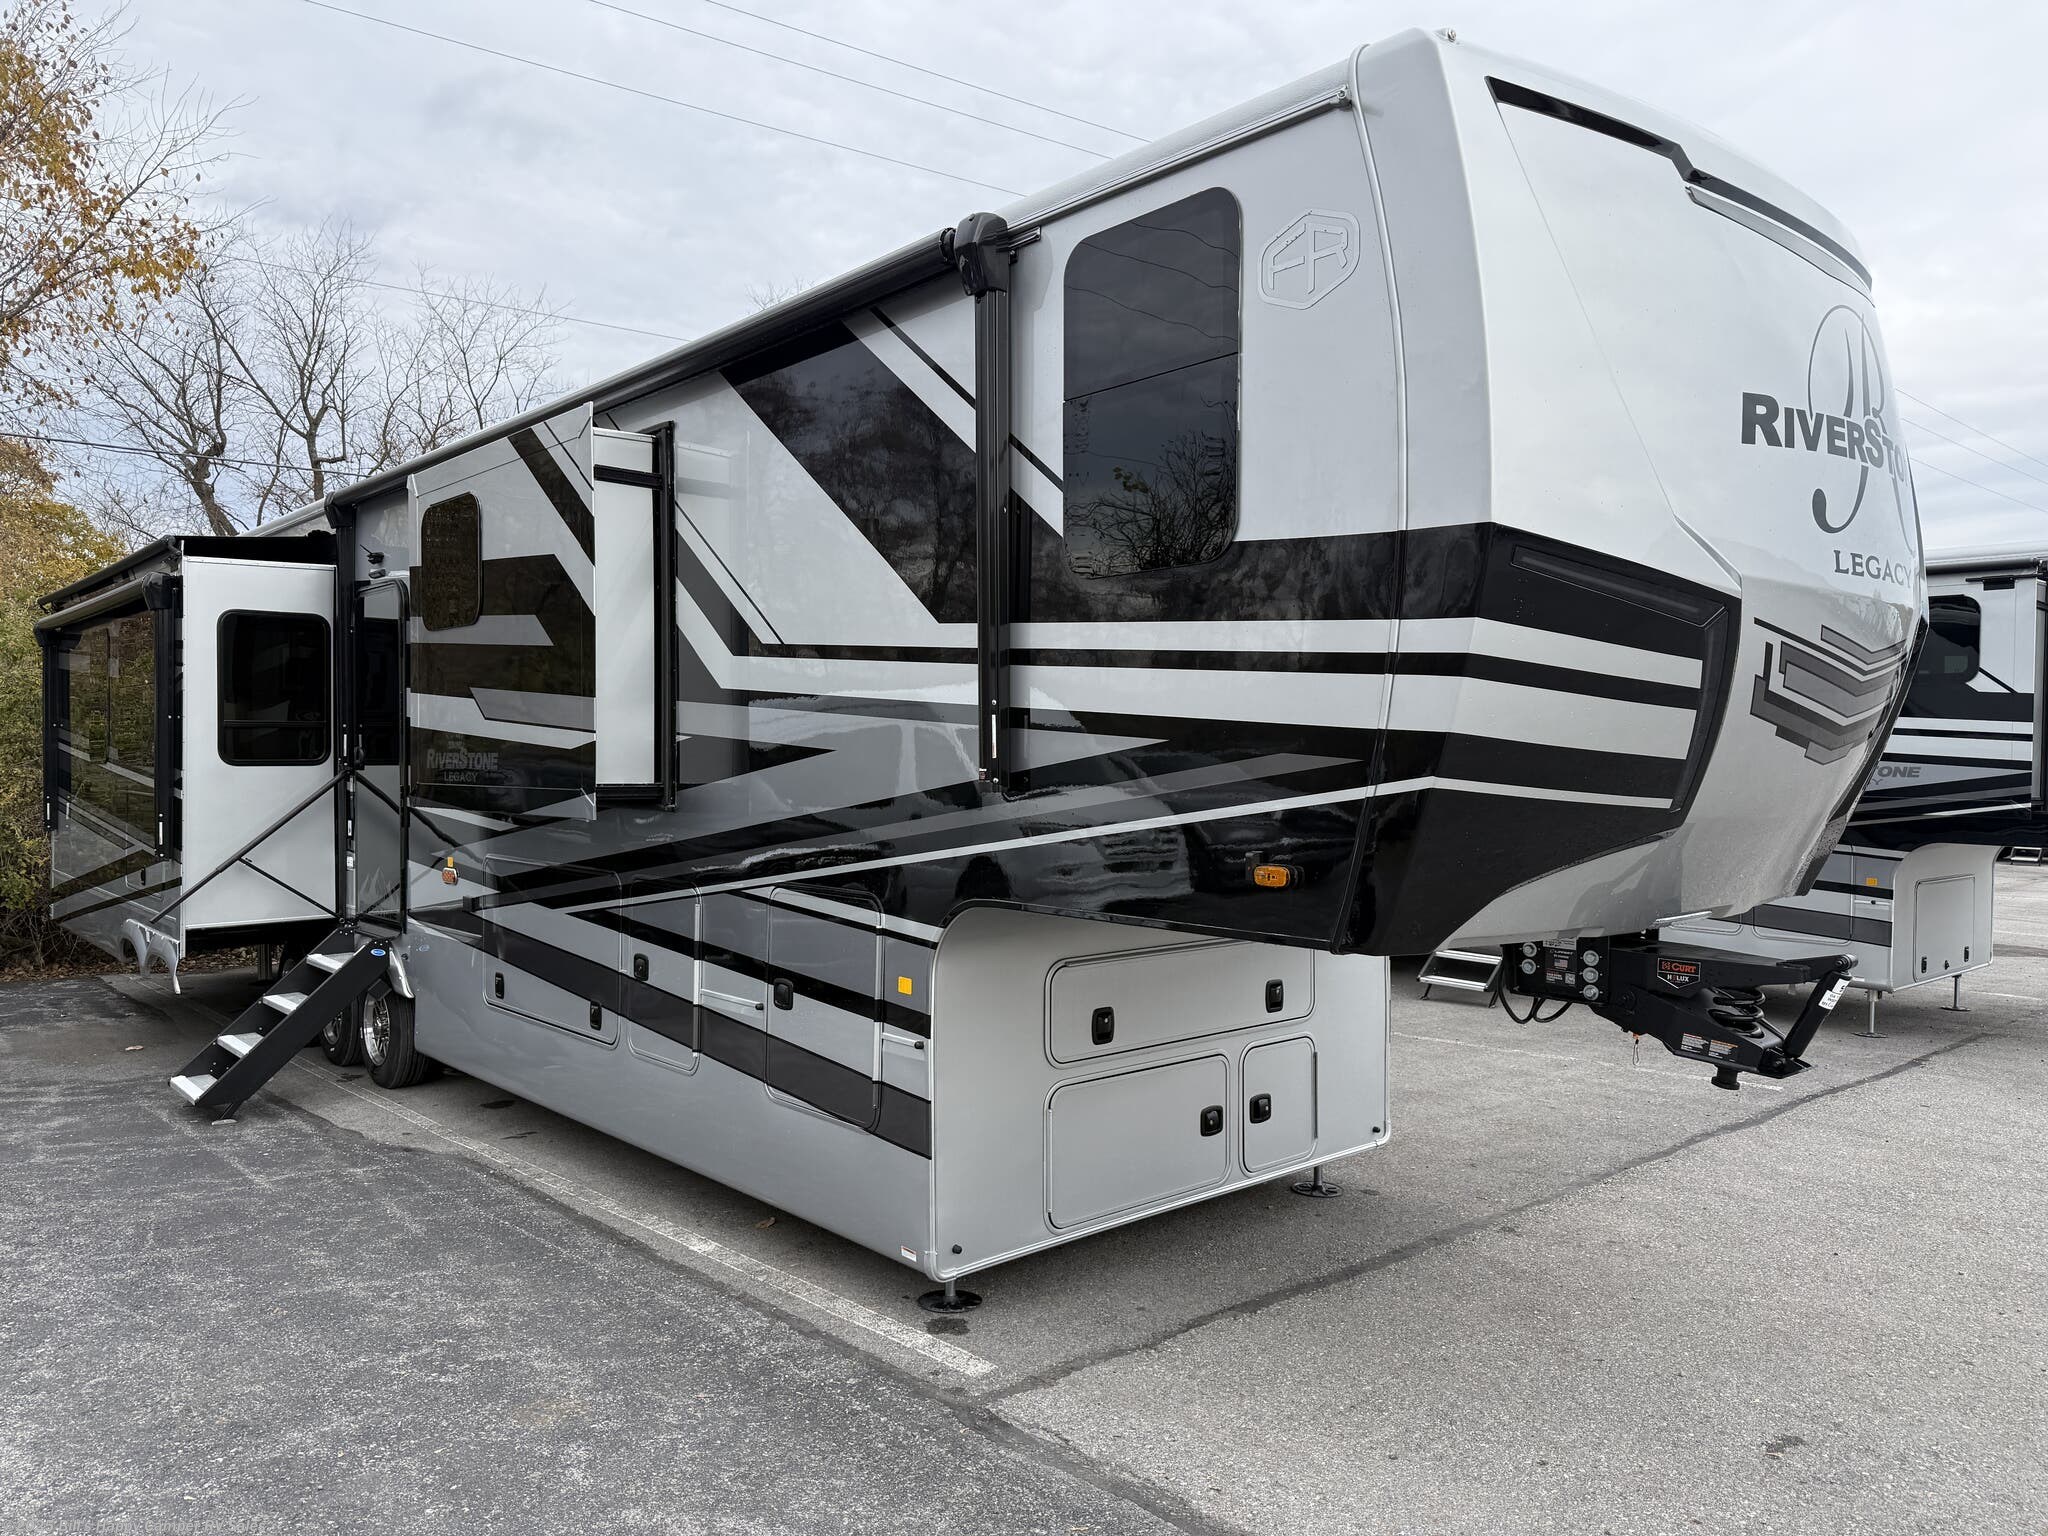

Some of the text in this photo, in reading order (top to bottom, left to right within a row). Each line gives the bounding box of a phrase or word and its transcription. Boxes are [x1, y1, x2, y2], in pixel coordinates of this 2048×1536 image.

[1741, 391, 1909, 487] RIVERSTO
[1833, 549, 1912, 589] LEGACY
[426, 748, 499, 771] RIVERSTONE
[443, 770, 479, 783] LEGACY
[1876, 765, 1922, 778] ONE
[1671, 962, 1697, 973] CURT
